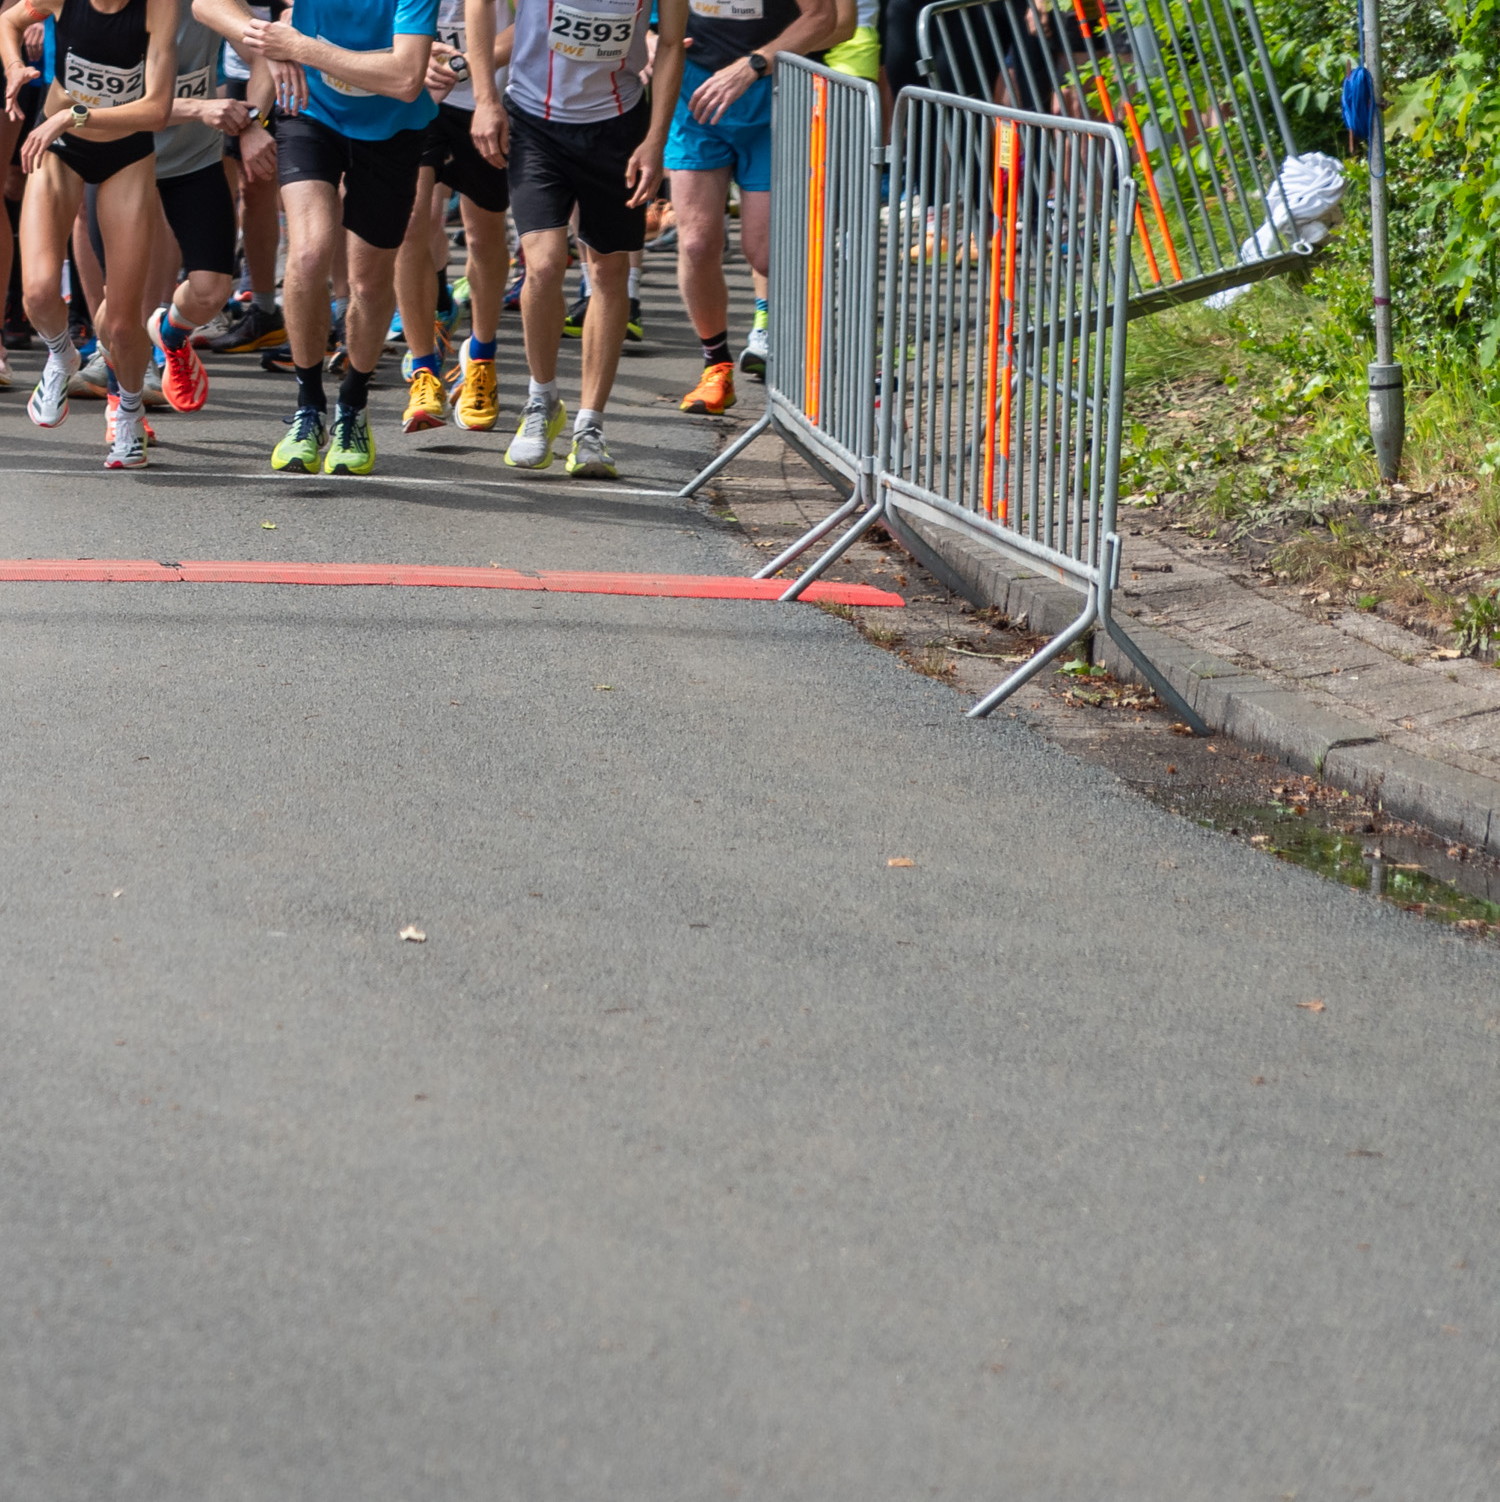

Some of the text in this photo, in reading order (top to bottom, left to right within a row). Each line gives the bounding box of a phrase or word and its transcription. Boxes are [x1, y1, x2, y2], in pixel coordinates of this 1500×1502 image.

[558, 9, 592, 21] Everstener
[694, 1, 720, 15] EWE
[731, 5, 756, 15] bruns
[552, 16, 632, 42] 2593
[554, 42, 585, 57] EWE
[596, 48, 623, 57] bruns
[67, 65, 142, 95] 2592
[72, 90, 101, 105] EWE
